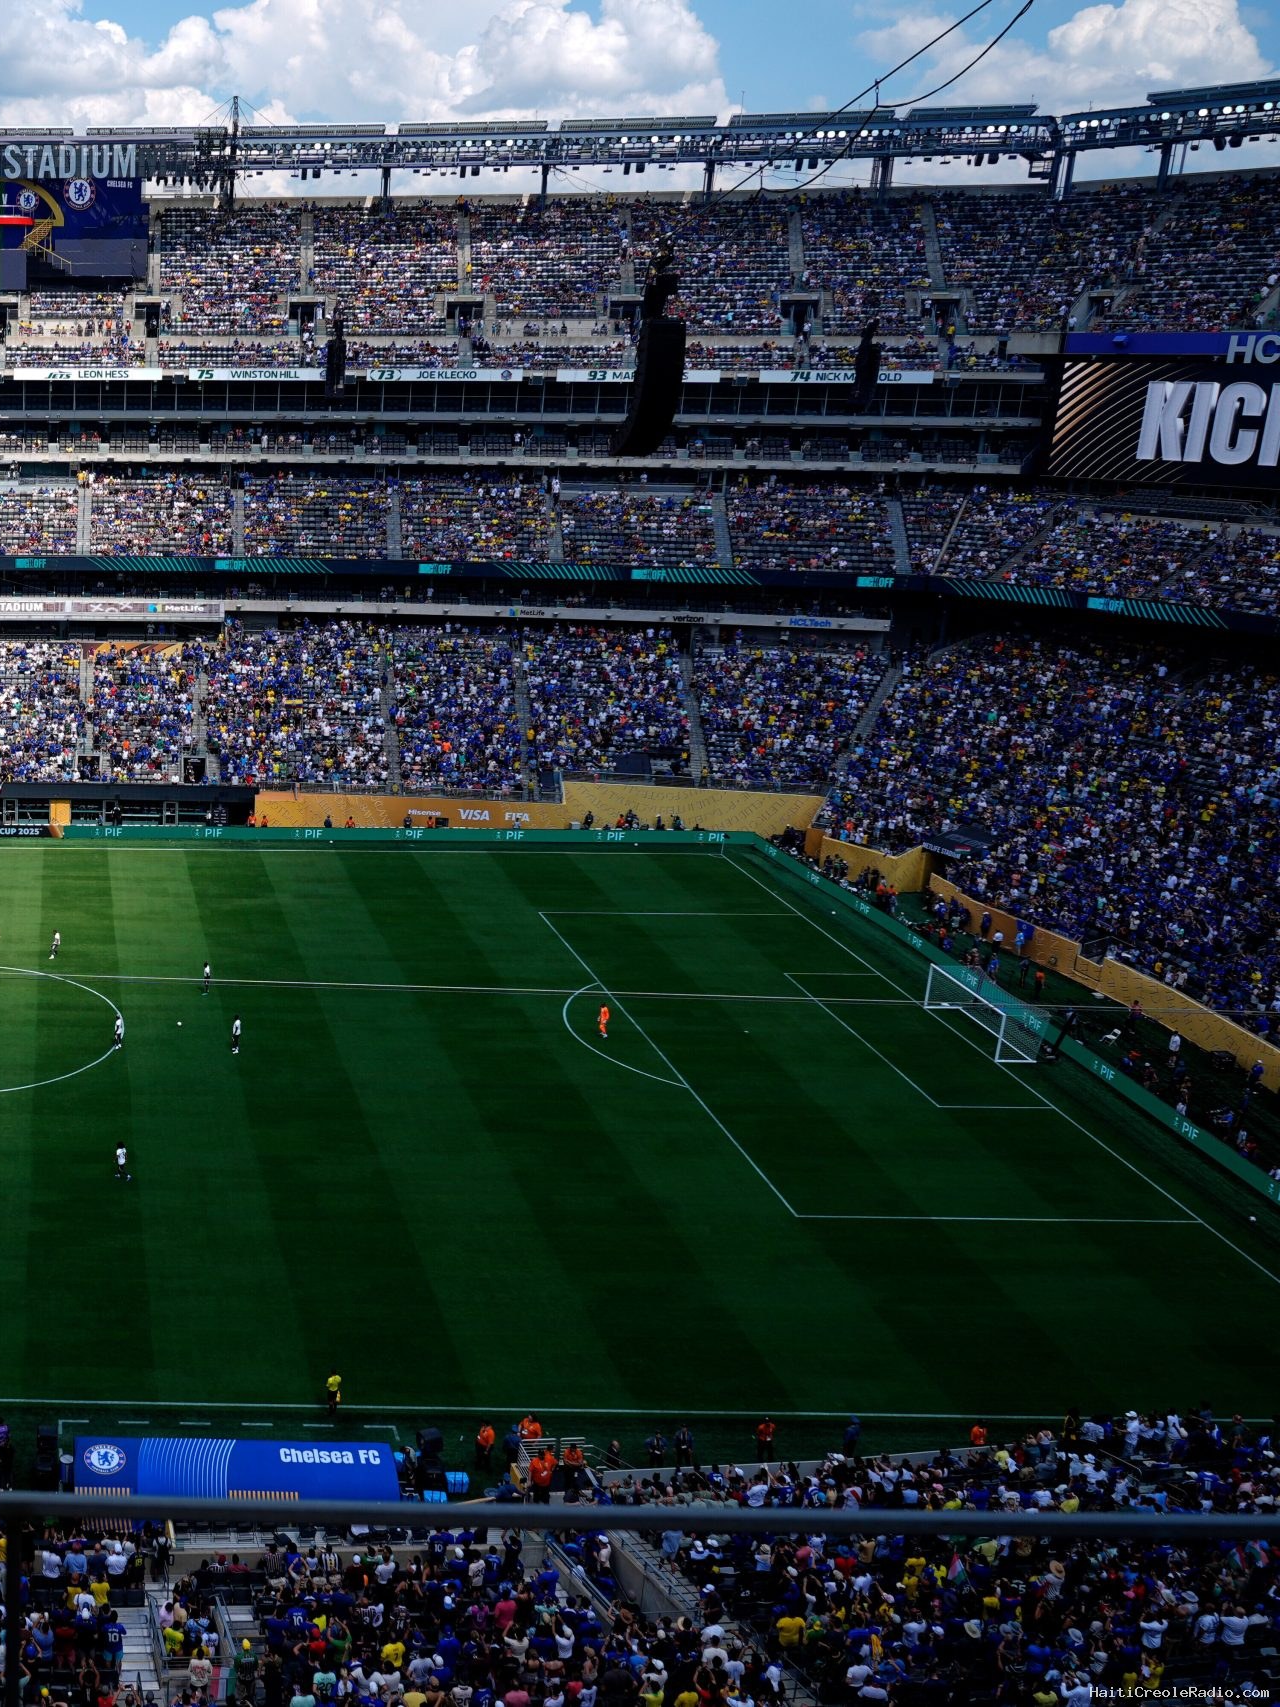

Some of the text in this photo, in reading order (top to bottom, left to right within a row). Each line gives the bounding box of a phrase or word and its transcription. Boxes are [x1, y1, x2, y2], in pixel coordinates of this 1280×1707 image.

[4, 144, 136, 179] STADIUM
[107, 180, 126, 188] CHELSEA
[45, 370, 129, 379] JETS LEON HESS
[197, 369, 300, 379] 75 WINSTON HILL
[377, 370, 477, 379] 73 JOE KLECKO
[587, 370, 607, 381] 93
[790, 371, 902, 382] 74 NICK MOLD
[520, 608, 545, 617] MetLife
[673, 614, 704, 623] verizon
[789, 617, 831, 628] HCLTech
[408, 808, 441, 817] Hisense
[458, 808, 490, 821] VISA
[505, 812, 530, 822] FIFA
[0, 827, 17, 836] CUP
[105, 827, 122, 837] PIF
[205, 828, 222, 838] PIF
[305, 829, 322, 839] PIF
[506, 831, 524, 840] PIF
[607, 832, 625, 841] PIF
[922, 841, 941, 852] METLIFE
[811, 873, 820, 885] PIF
[860, 902, 871, 915] PIF
[912, 934, 923, 948] PIF
[966, 973, 979, 988] PIF
[1100, 1064, 1115, 1081] PIF
[1182, 1121, 1199, 1139] PIF
[280, 1447, 381, 1465] Chelsea FC
